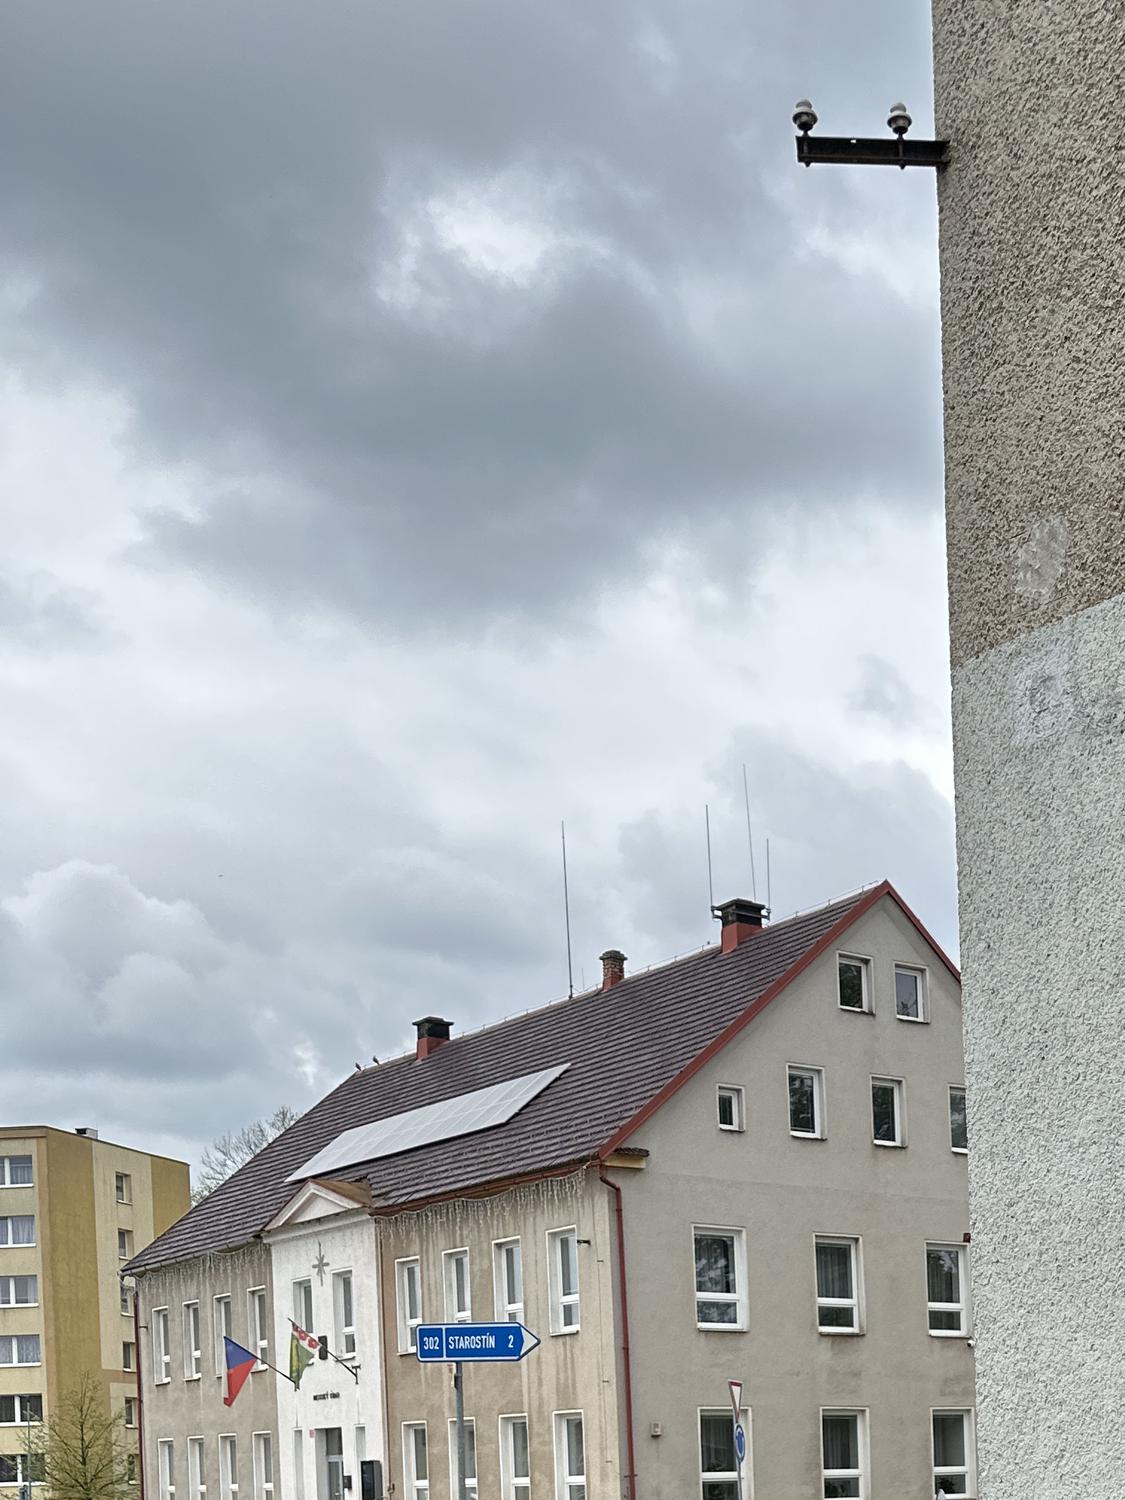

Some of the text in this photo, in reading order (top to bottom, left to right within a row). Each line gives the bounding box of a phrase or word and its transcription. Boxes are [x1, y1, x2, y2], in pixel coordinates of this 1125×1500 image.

[423, 1332, 514, 1350] 302 STAROSTÍN 2
